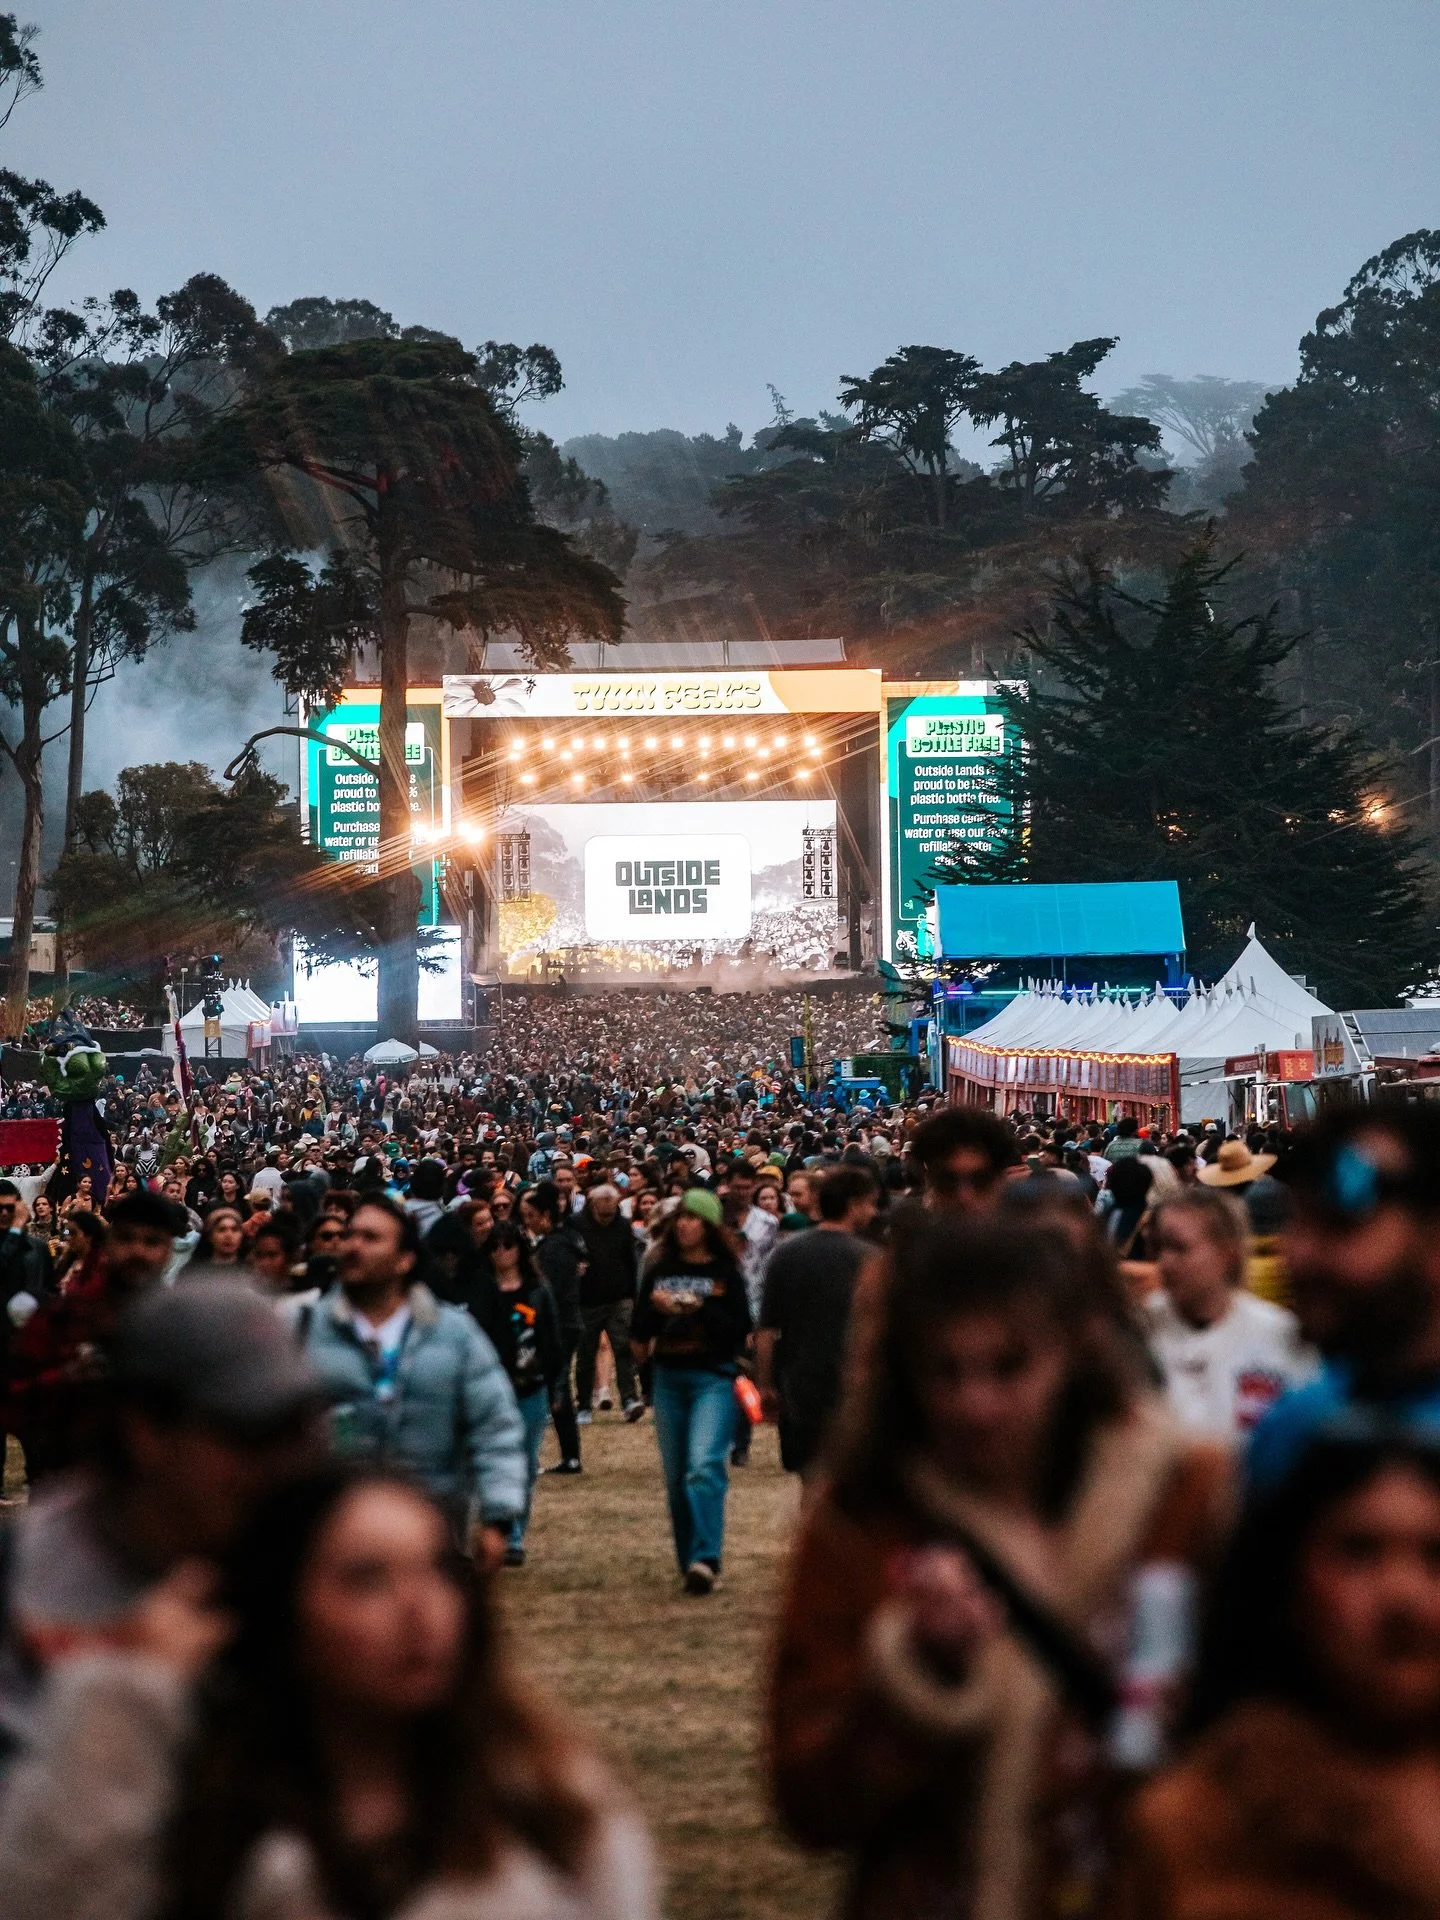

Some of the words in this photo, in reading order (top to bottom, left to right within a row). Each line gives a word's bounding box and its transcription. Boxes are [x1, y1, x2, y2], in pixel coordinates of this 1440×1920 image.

[571, 682, 656, 711] TWIN
[662, 680, 761, 709] PEAKS
[926, 719, 985, 735] PLASTIC
[911, 736, 963, 752] BOTTLE
[965, 736, 1000, 752] FREE
[914, 764, 954, 777] Outside
[955, 764, 984, 777] Lands
[335, 773, 374, 785] Outside
[913, 779, 943, 792] proud
[944, 779, 956, 790] to
[957, 779, 970, 790] be
[333, 787, 363, 801] proud
[364, 787, 377, 799] to
[910, 793, 945, 806] plastic
[946, 792, 977, 805] bottle
[330, 801, 366, 814] plastic
[913, 813, 960, 825] Purchase
[333, 821, 380, 833] Purchase
[904, 828, 933, 839] water
[934, 828, 945, 839] or
[967, 827, 985, 838] our
[324, 836, 353, 847] water
[354, 836, 365, 847] or
[367, 836, 380, 847] us
[615, 860, 720, 886] OUTSIDE
[628, 888, 708, 915] LANDS
